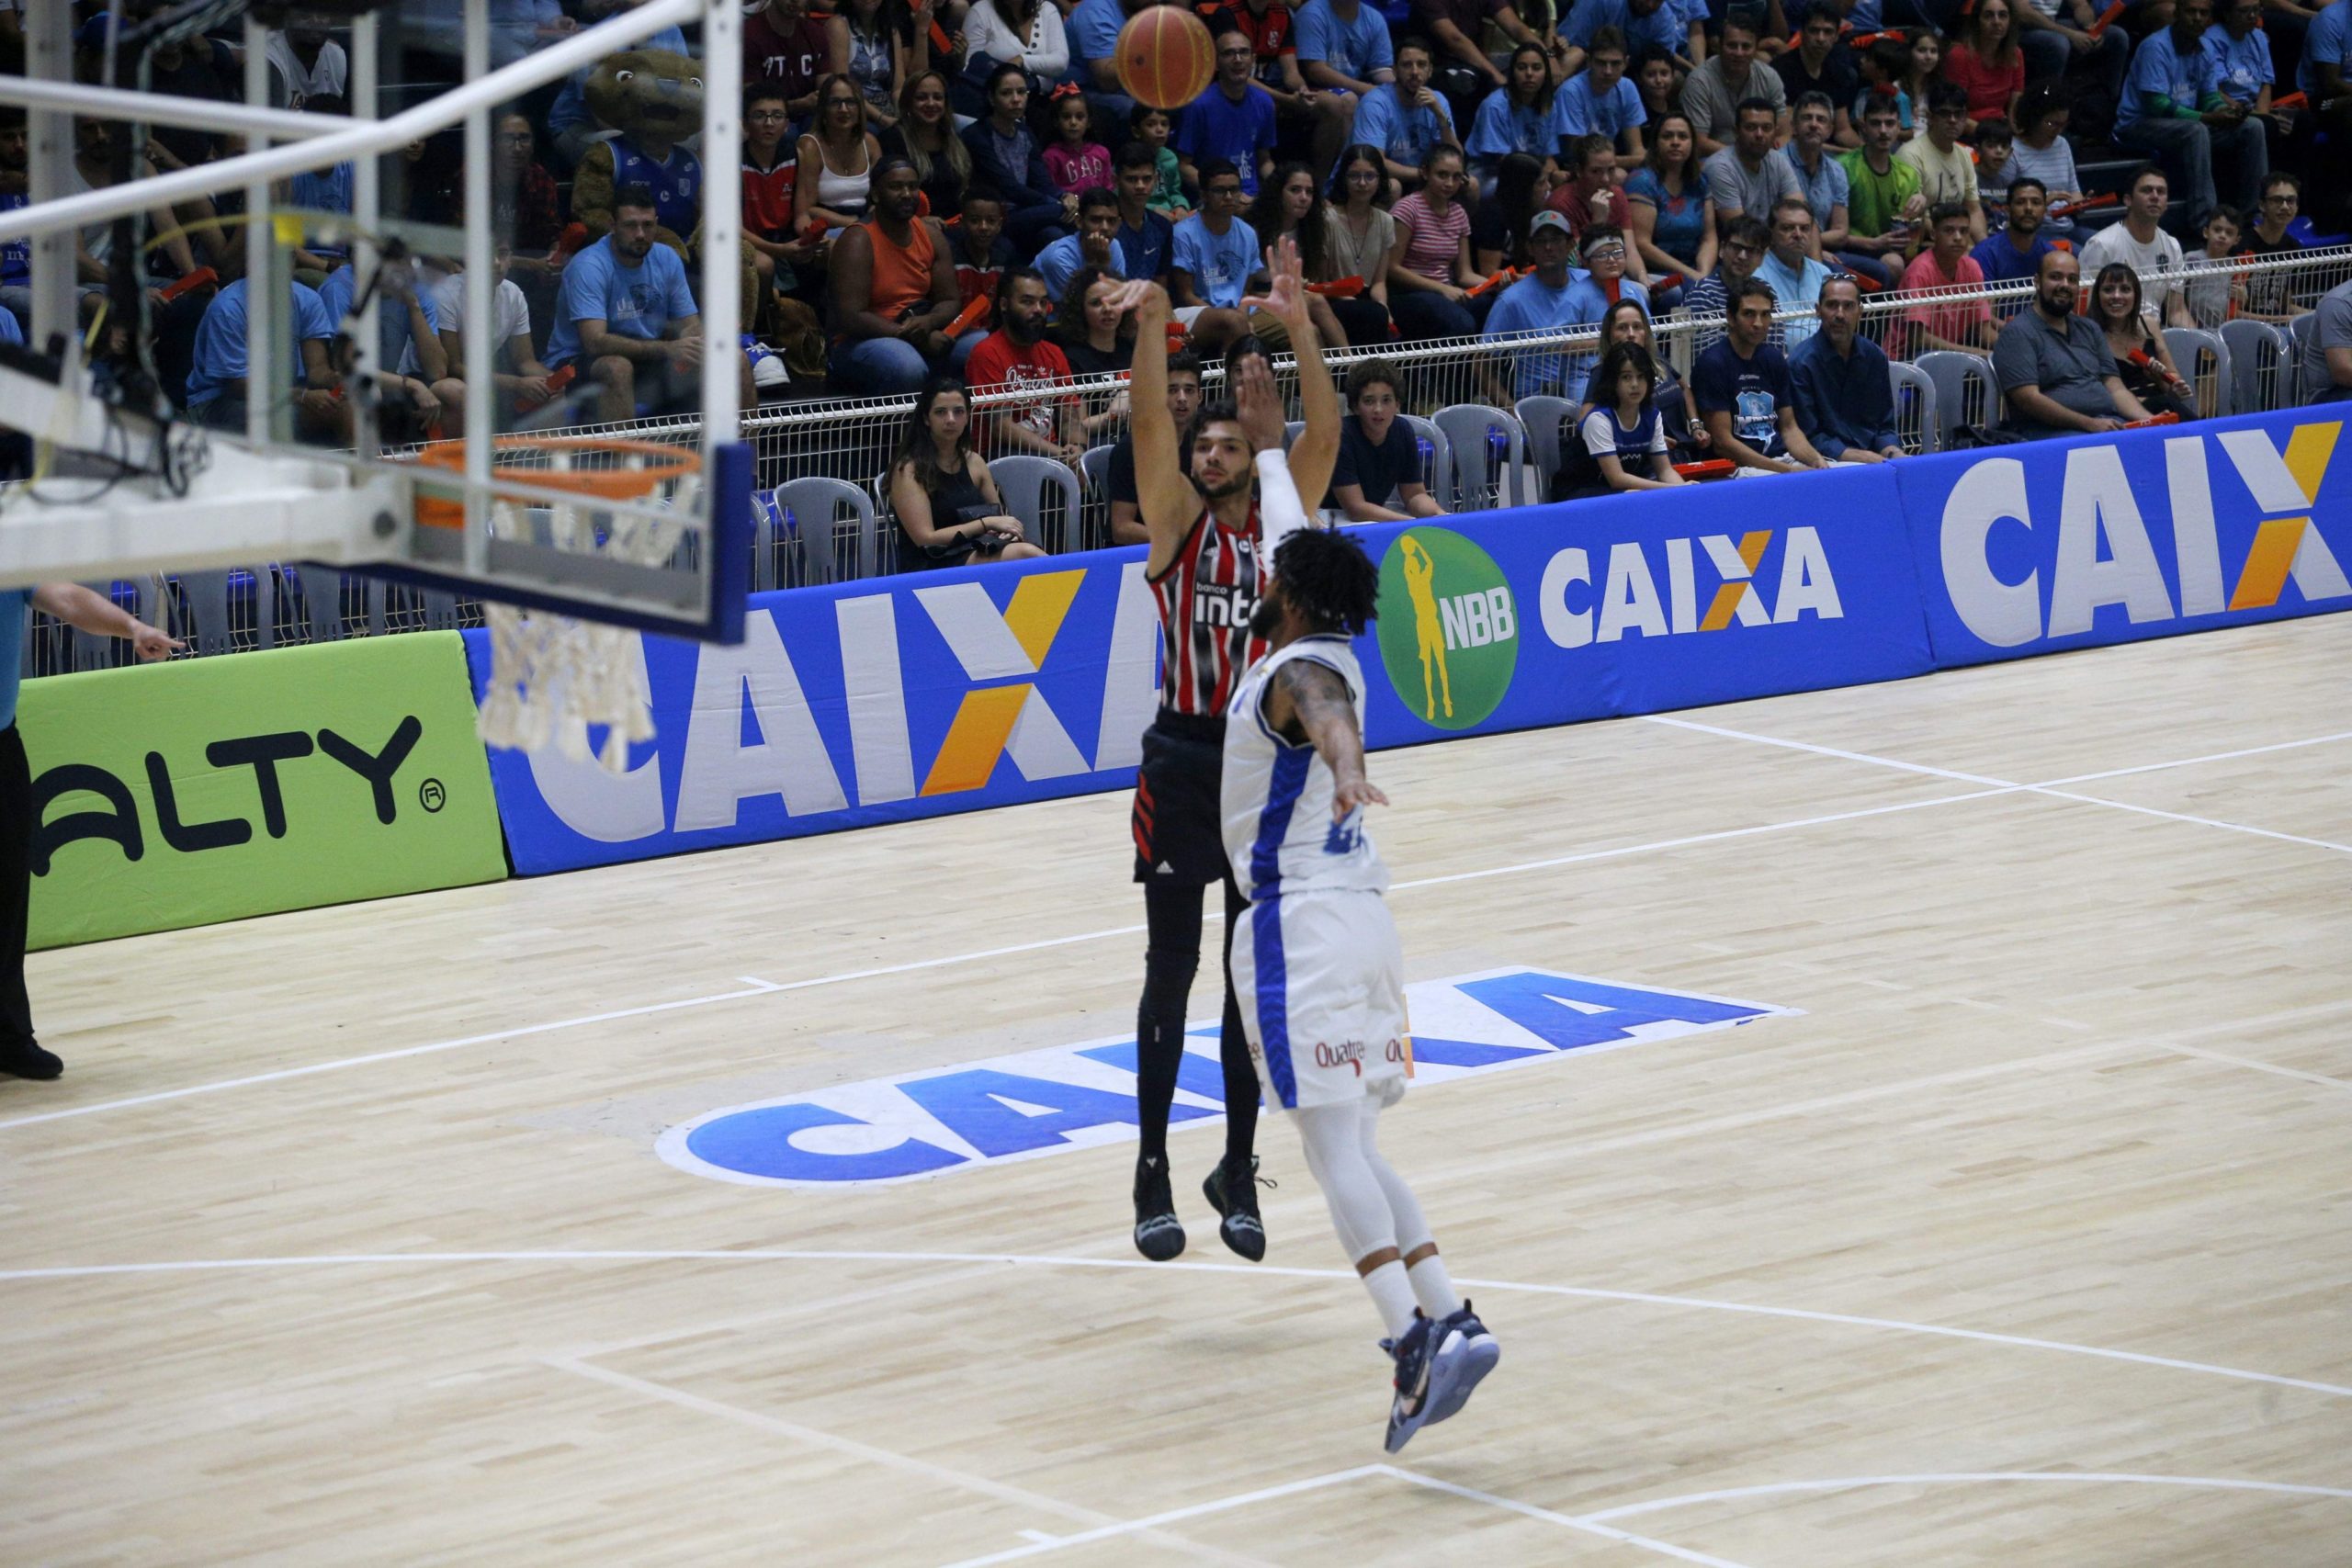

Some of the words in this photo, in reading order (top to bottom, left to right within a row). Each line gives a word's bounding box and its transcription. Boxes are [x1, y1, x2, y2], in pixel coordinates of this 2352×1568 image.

[1066, 155, 1102, 183] GAP
[1196, 582, 1227, 595] banco
[1539, 526, 1845, 649] CAIXA
[1440, 585, 1515, 650] NBB
